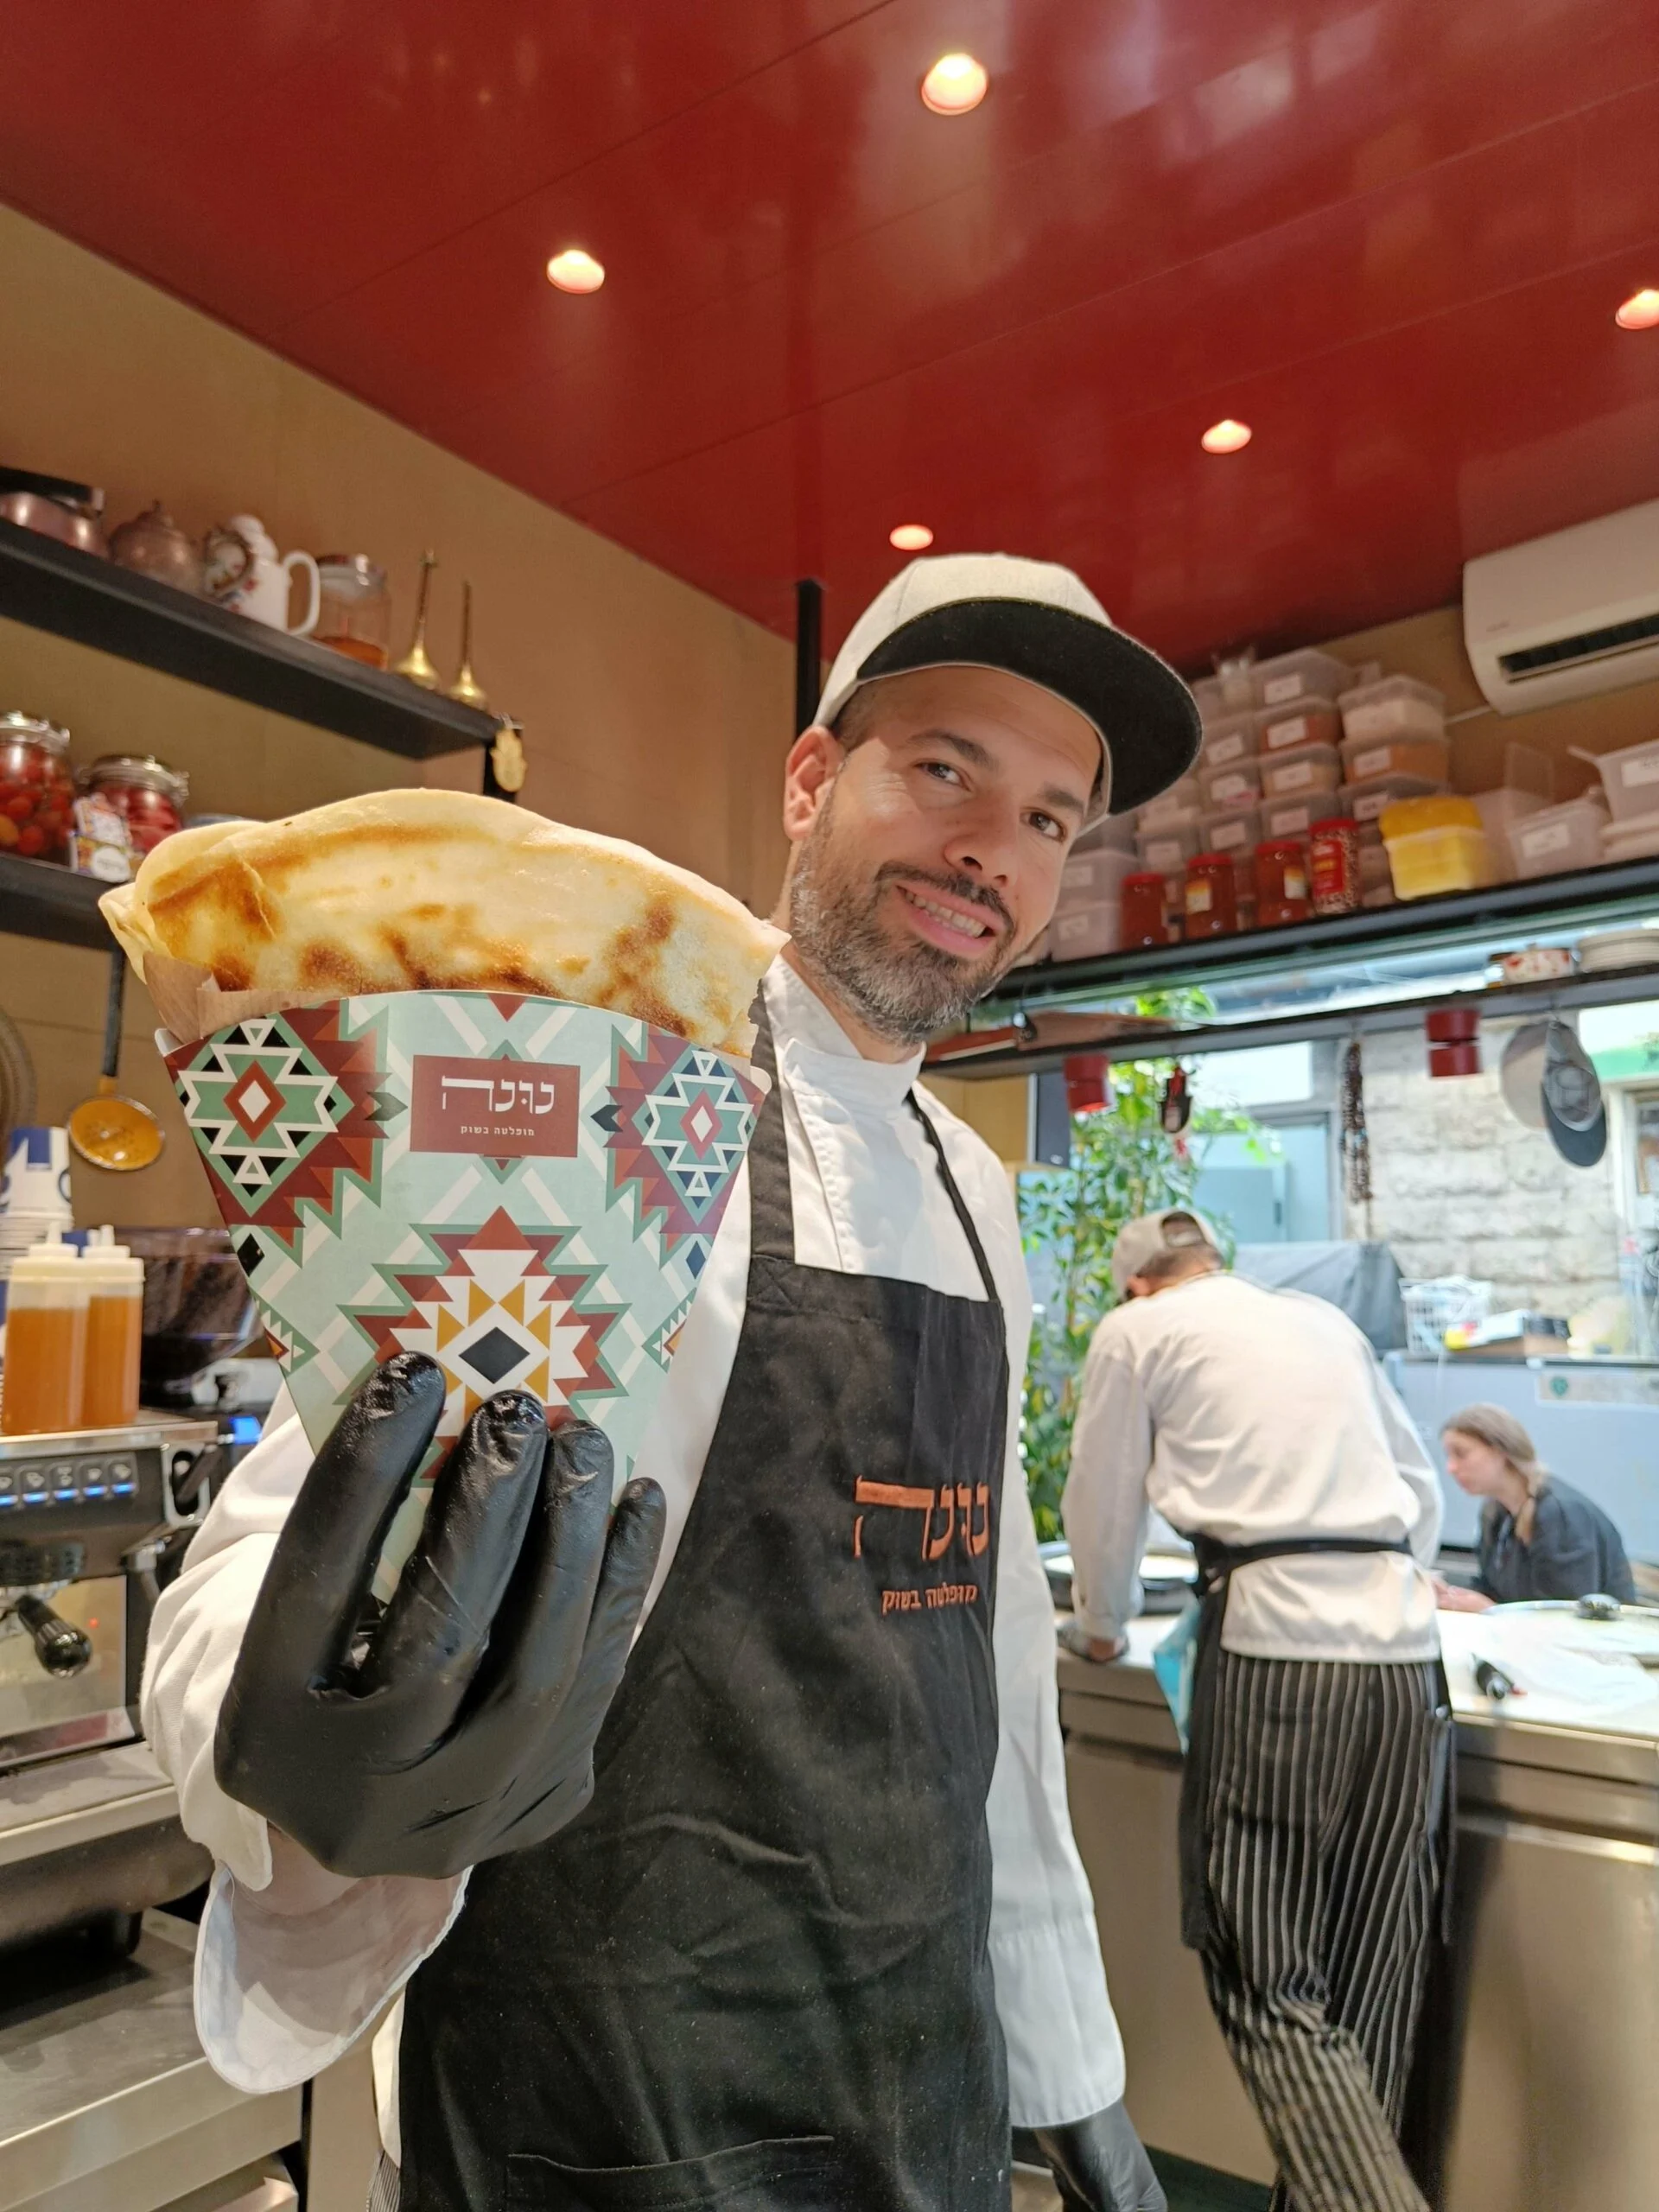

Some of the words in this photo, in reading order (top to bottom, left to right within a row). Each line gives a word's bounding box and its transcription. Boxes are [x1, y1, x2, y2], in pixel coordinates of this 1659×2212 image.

[494, 1126, 535, 1136] מופלטה
[882, 1590, 922, 1616] בשוק
[925, 1581, 978, 1609] מופלטה
